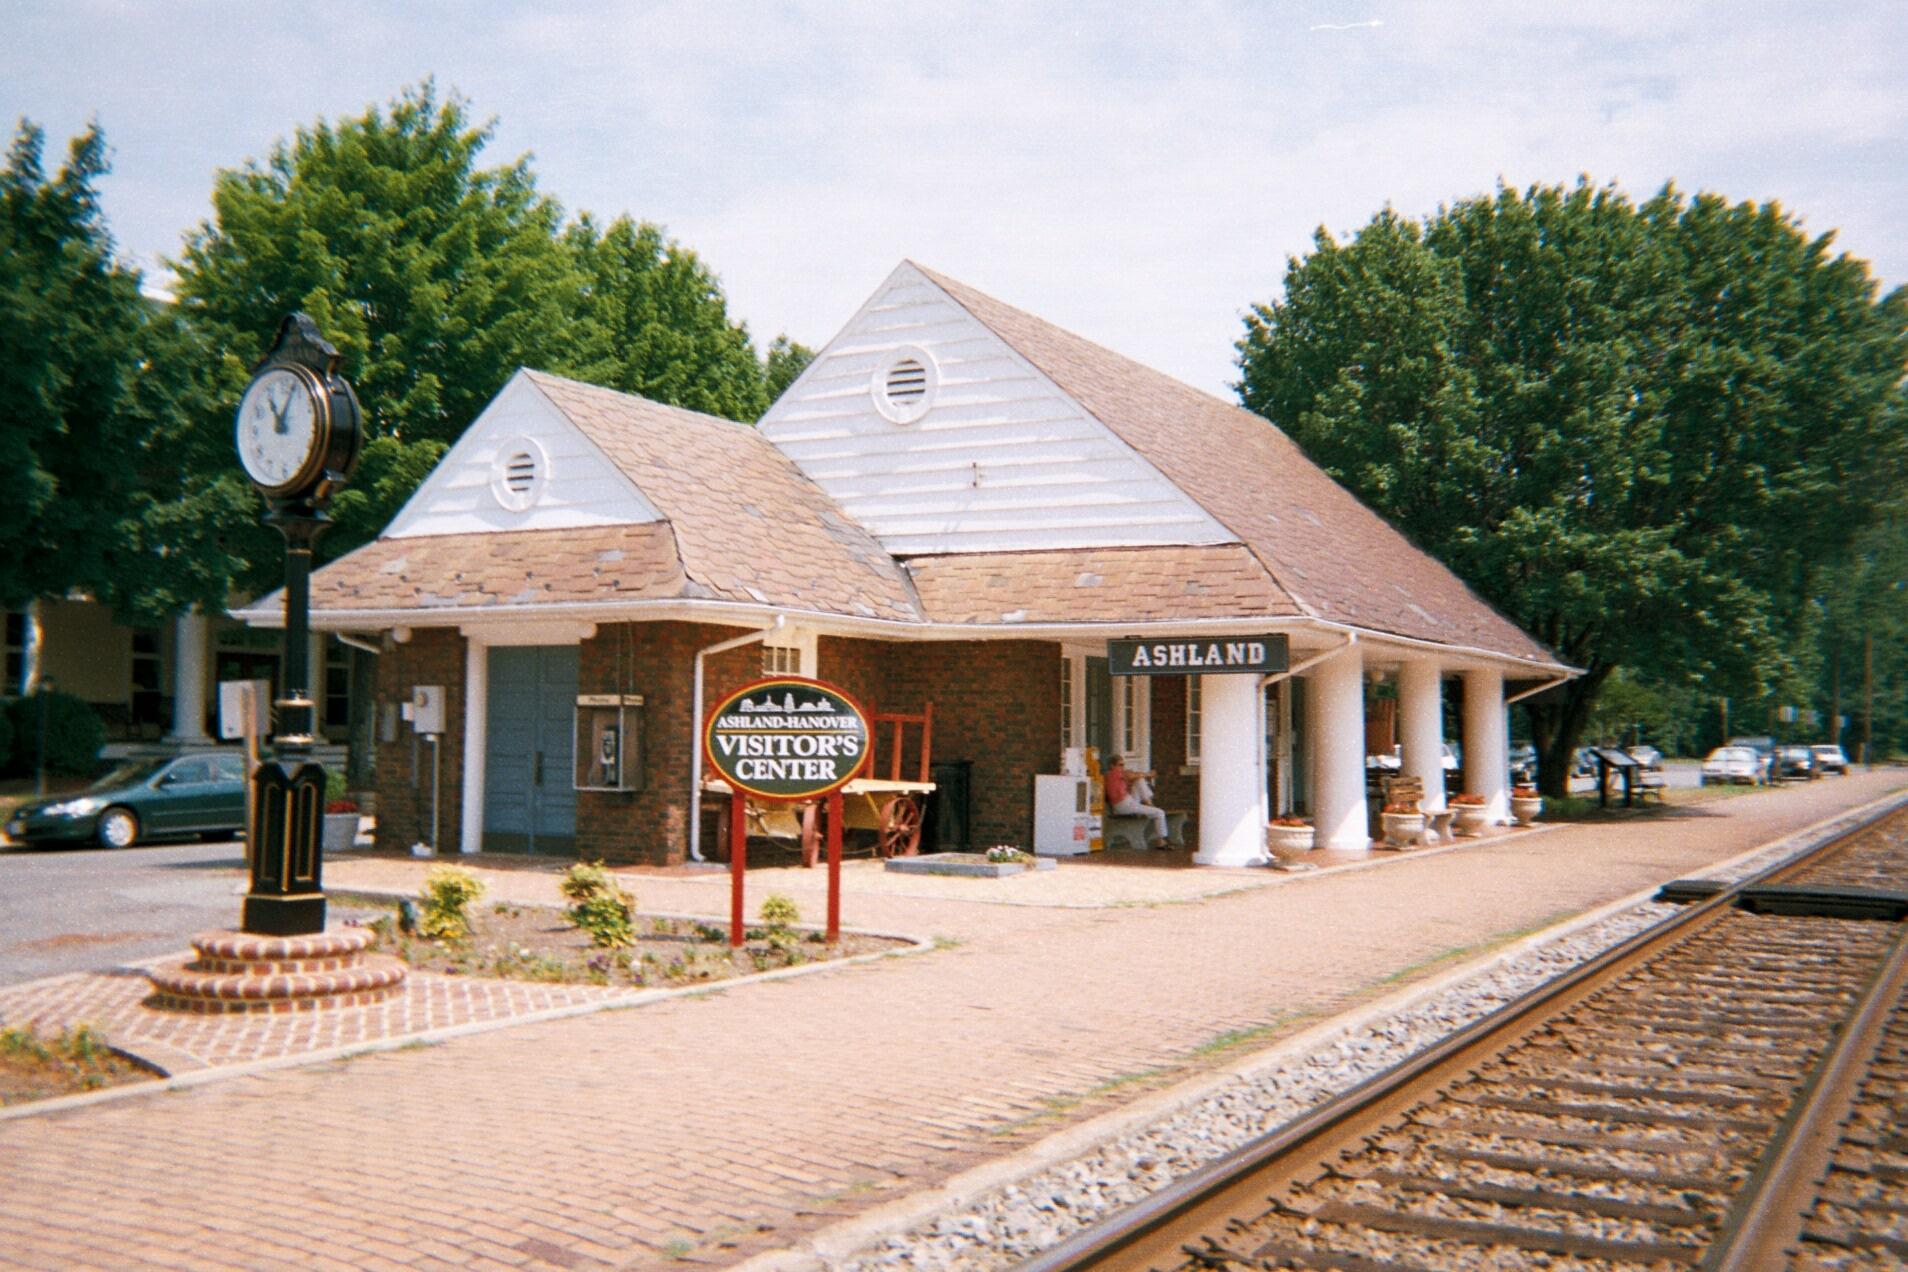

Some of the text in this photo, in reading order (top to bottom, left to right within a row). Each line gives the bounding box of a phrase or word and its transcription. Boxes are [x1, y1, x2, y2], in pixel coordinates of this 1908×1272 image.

[1132, 642, 1266, 667] ASHLAND
[717, 715, 858, 729] ASHLAND-HANOVER
[715, 735, 859, 756] VISITOR'S
[736, 759, 837, 780] CENTER
